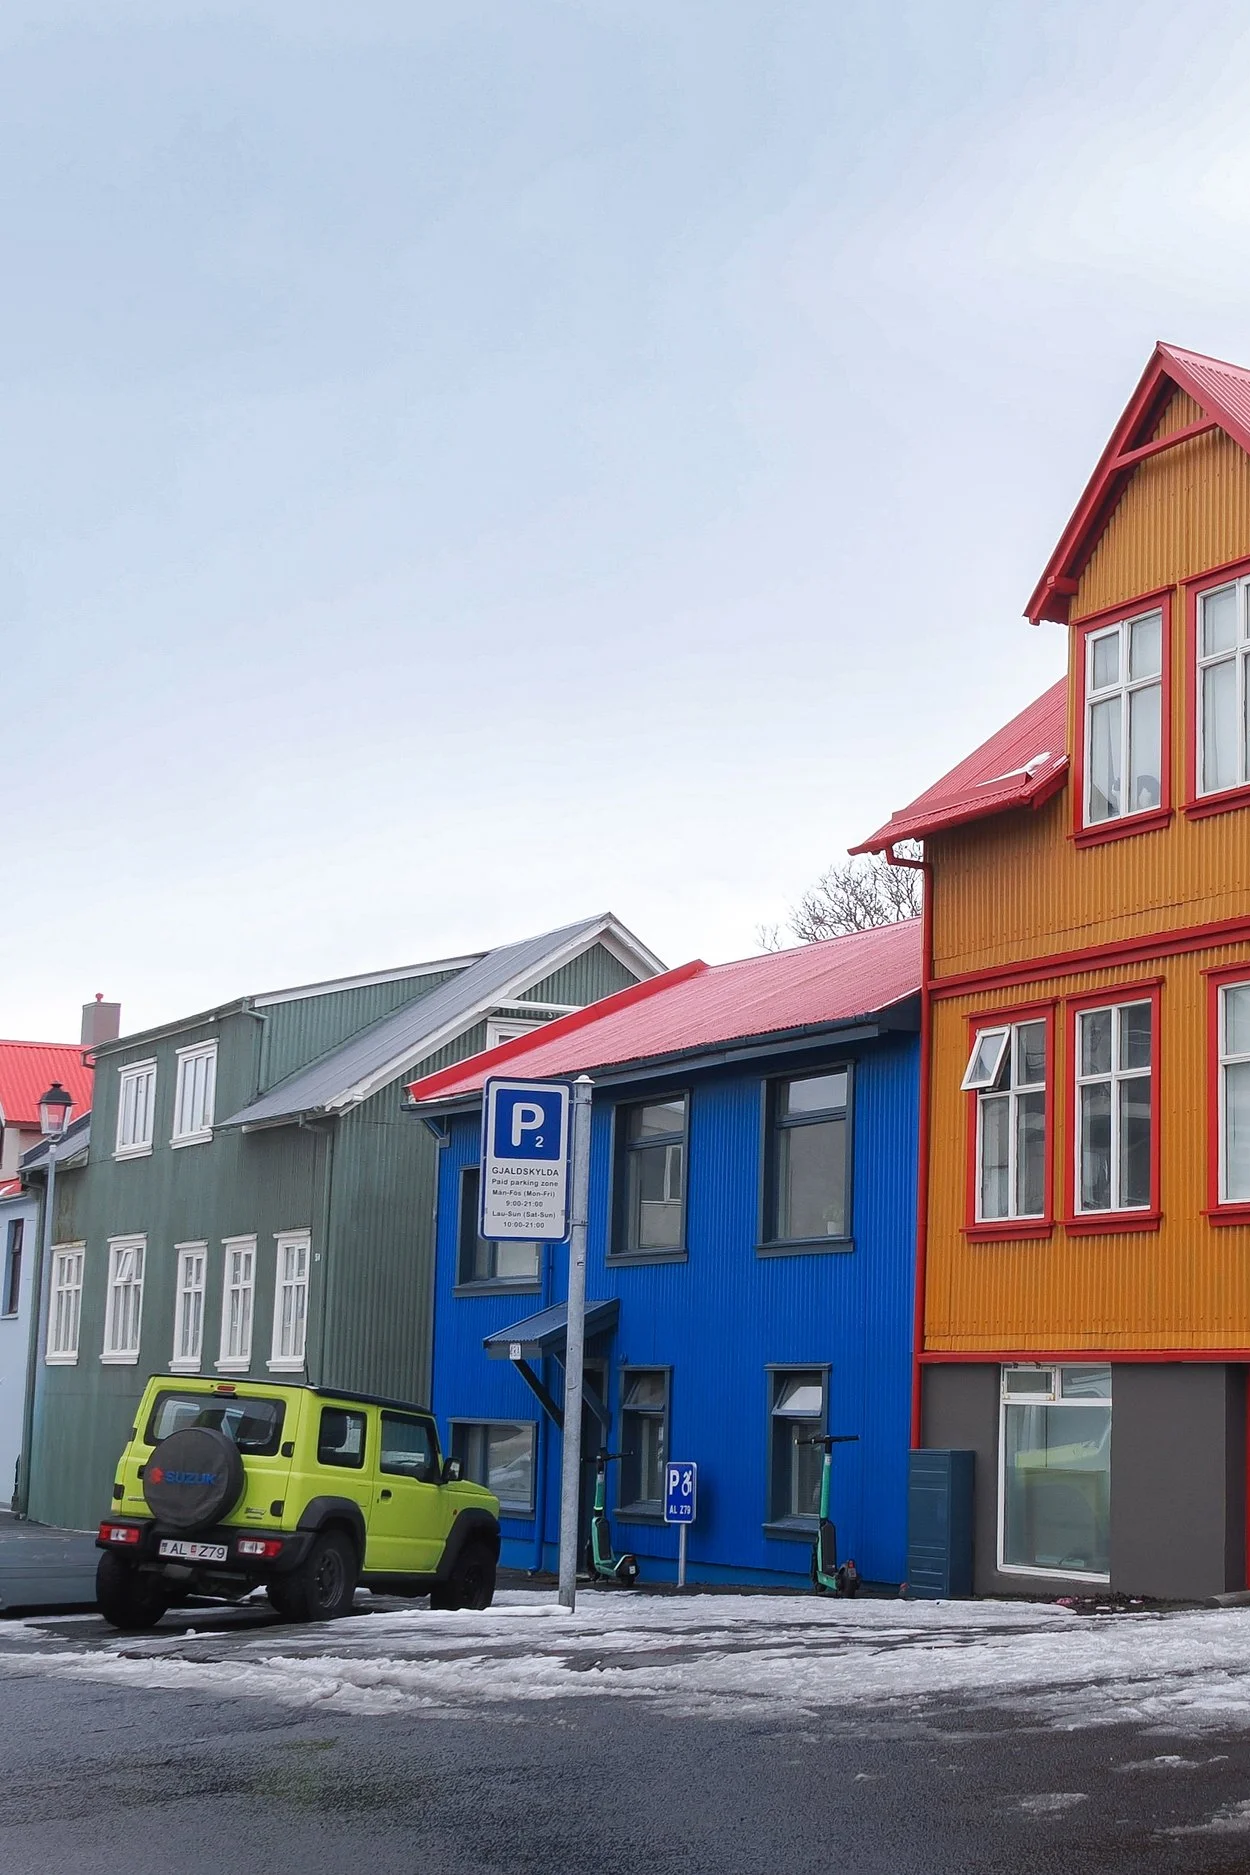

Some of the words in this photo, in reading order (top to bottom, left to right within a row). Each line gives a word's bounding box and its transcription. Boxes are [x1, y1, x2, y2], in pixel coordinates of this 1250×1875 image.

[511, 1102, 545, 1147] P
[534, 1135, 545, 1148] 2
[491, 1166, 559, 1176] GJALDSKYLDA
[523, 1190, 555, 1198] (Mon-Fri)
[523, 1211, 556, 1219] (Sat-Sun)
[669, 1470, 680, 1495] P
[669, 1505, 677, 1514] AL
[169, 1543, 187, 1555] AL
[198, 1545, 225, 1559] Z79
